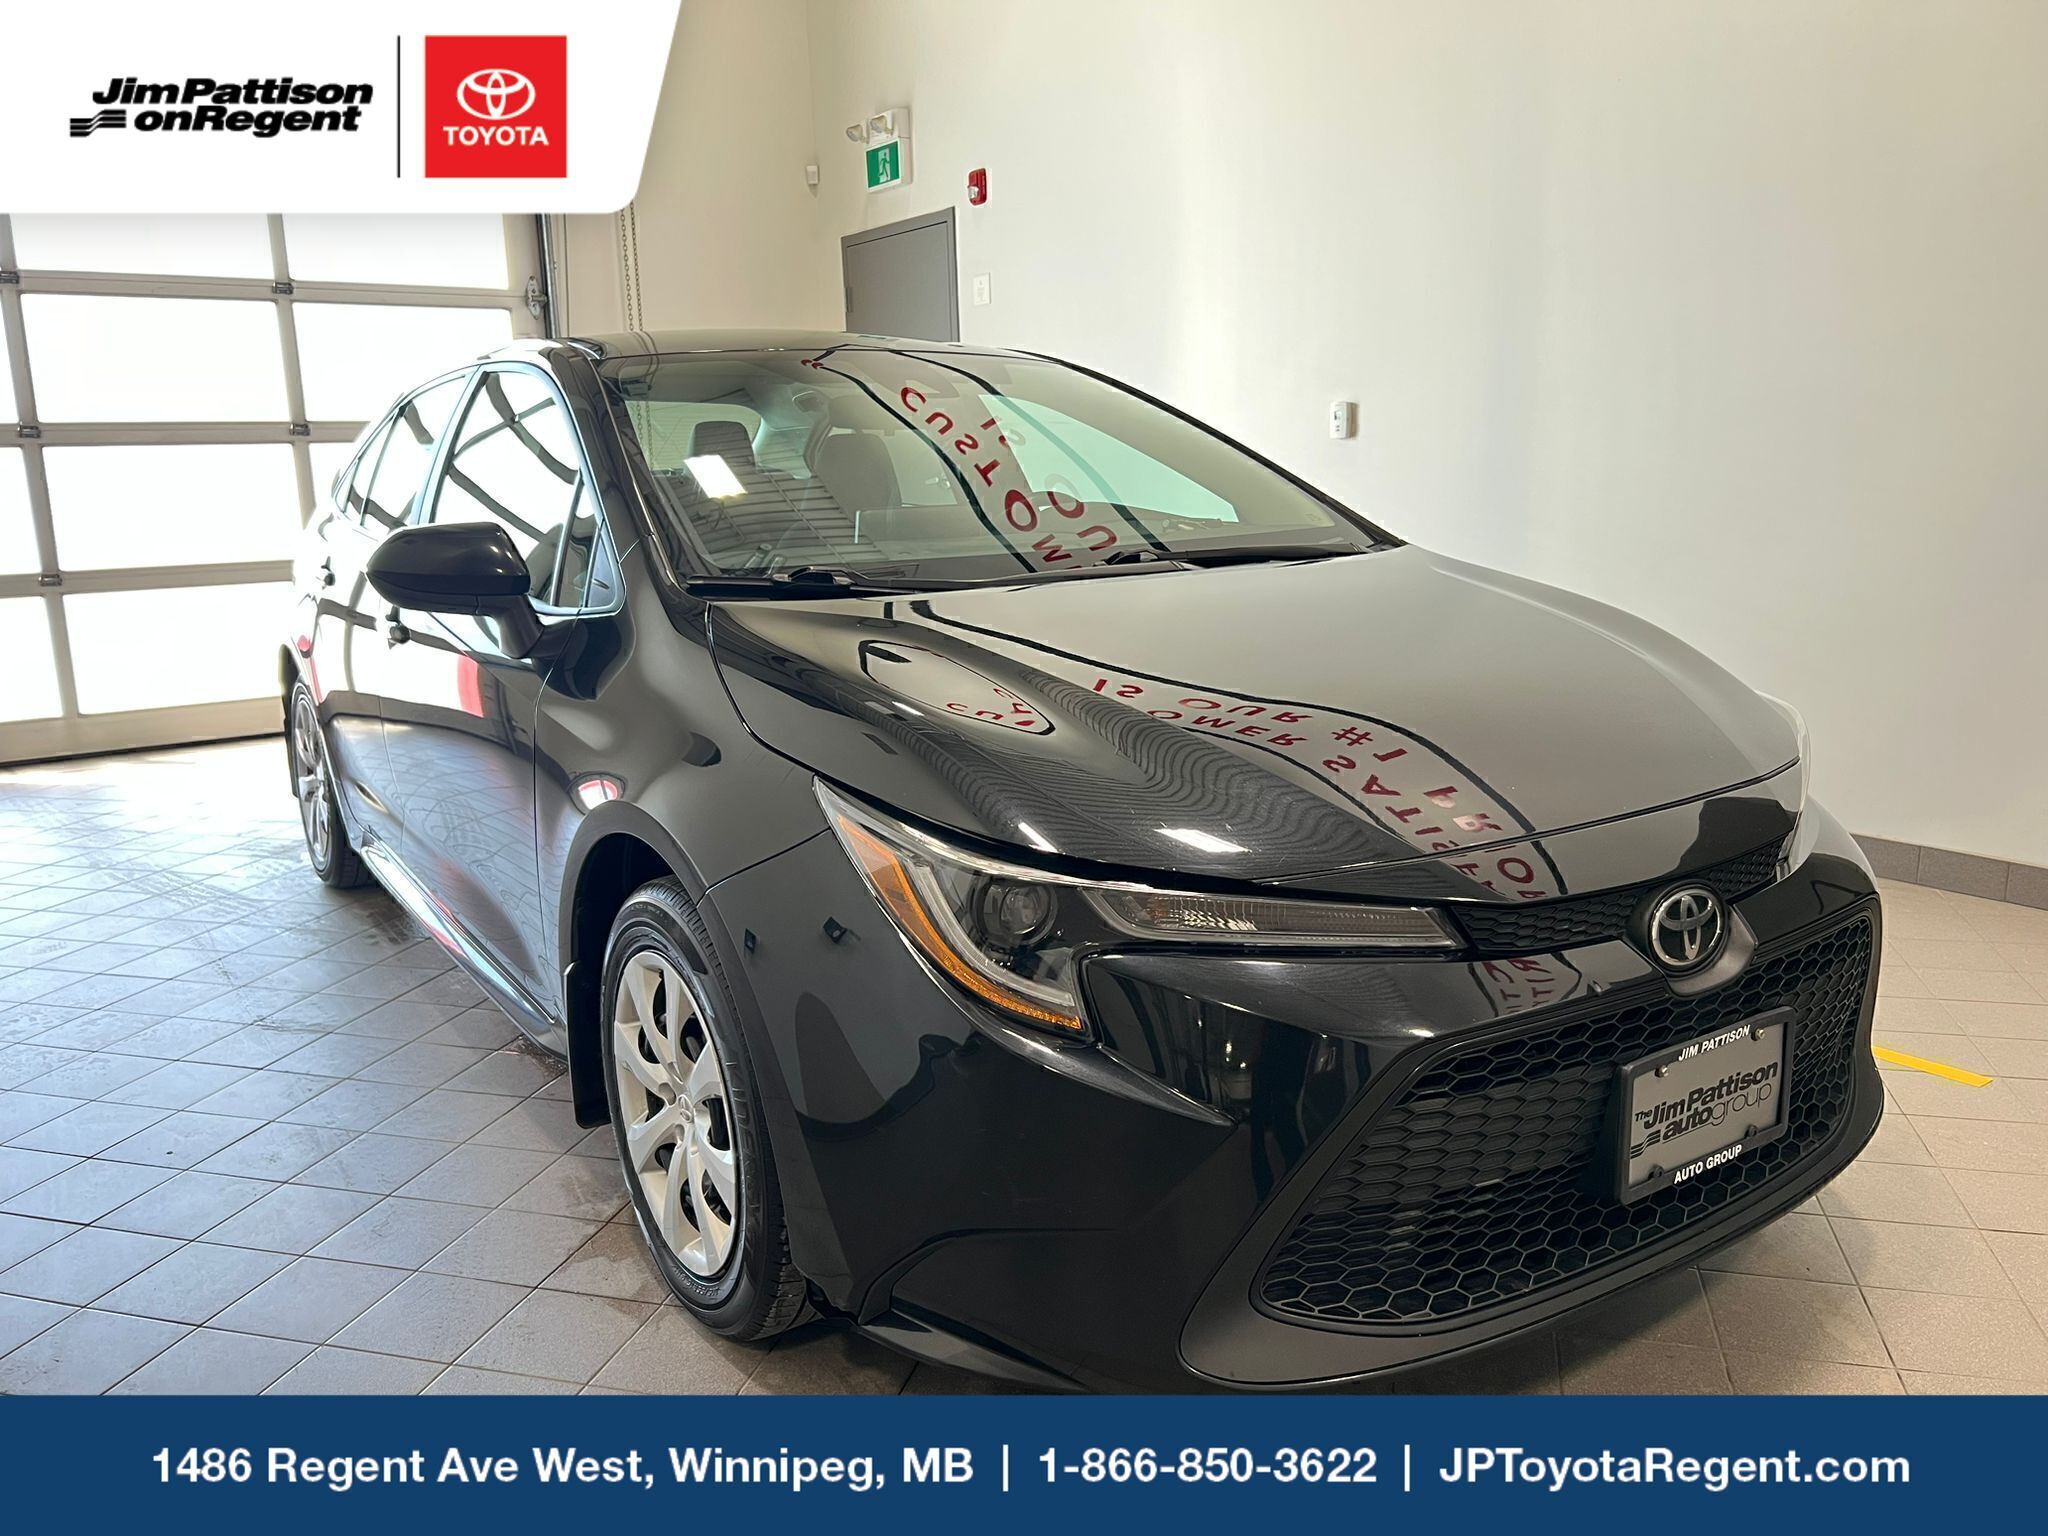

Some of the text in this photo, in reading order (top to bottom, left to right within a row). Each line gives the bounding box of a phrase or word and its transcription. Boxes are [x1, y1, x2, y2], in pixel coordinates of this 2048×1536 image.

[1678, 1024, 1751, 1061] JIM PATTISON
[1635, 1108, 1653, 1122] The
[1674, 1144, 1742, 1184] AUTO GROUP
